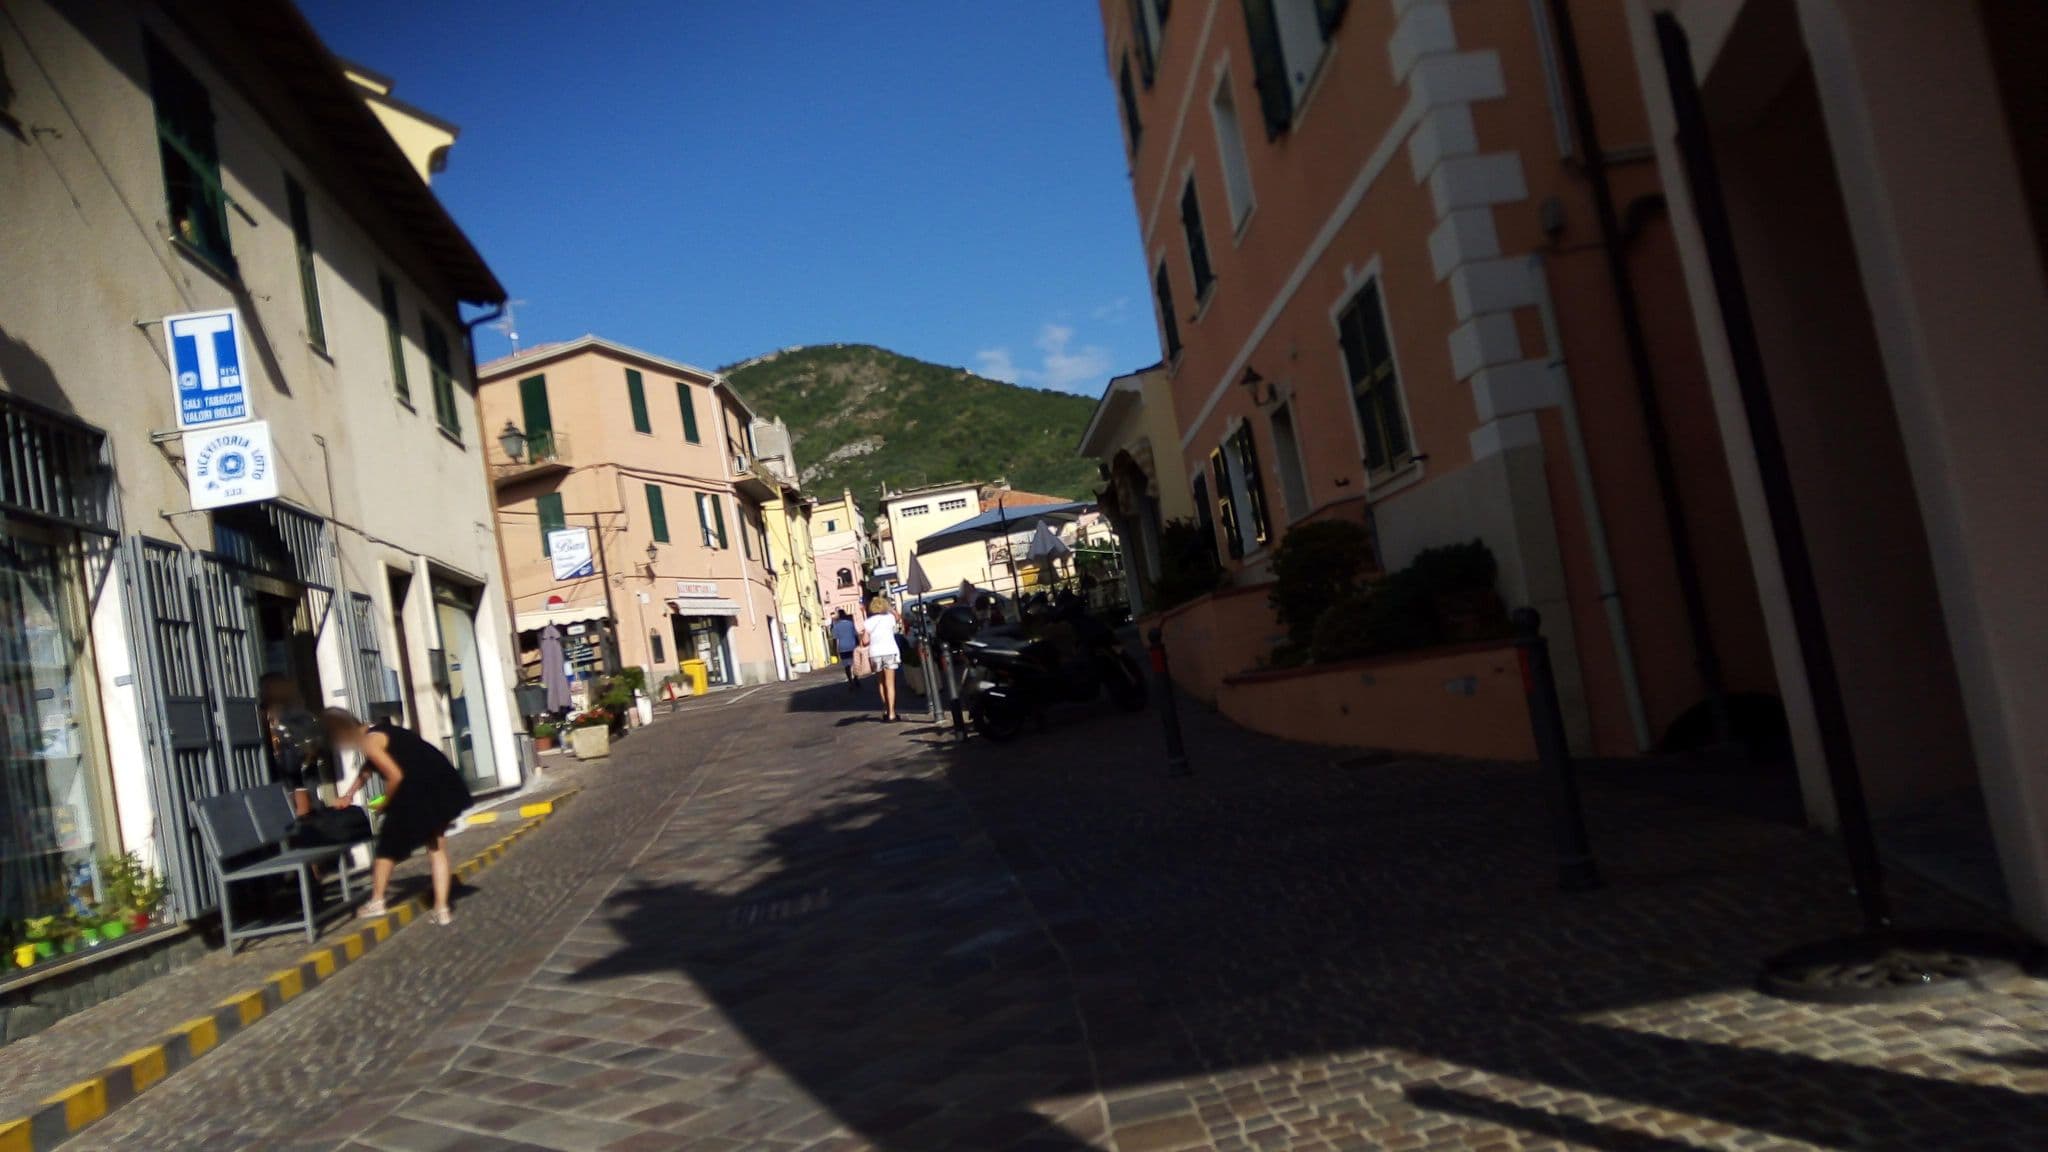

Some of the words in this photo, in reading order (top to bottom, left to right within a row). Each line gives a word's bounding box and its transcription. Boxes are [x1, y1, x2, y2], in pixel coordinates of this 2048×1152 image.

[174, 315, 230, 391] T
[184, 410, 212, 423] VALORI
[213, 405, 245, 419] BOLLATI
[204, 391, 243, 408] TABACCHI
[197, 435, 250, 477] RICEVITORIA
